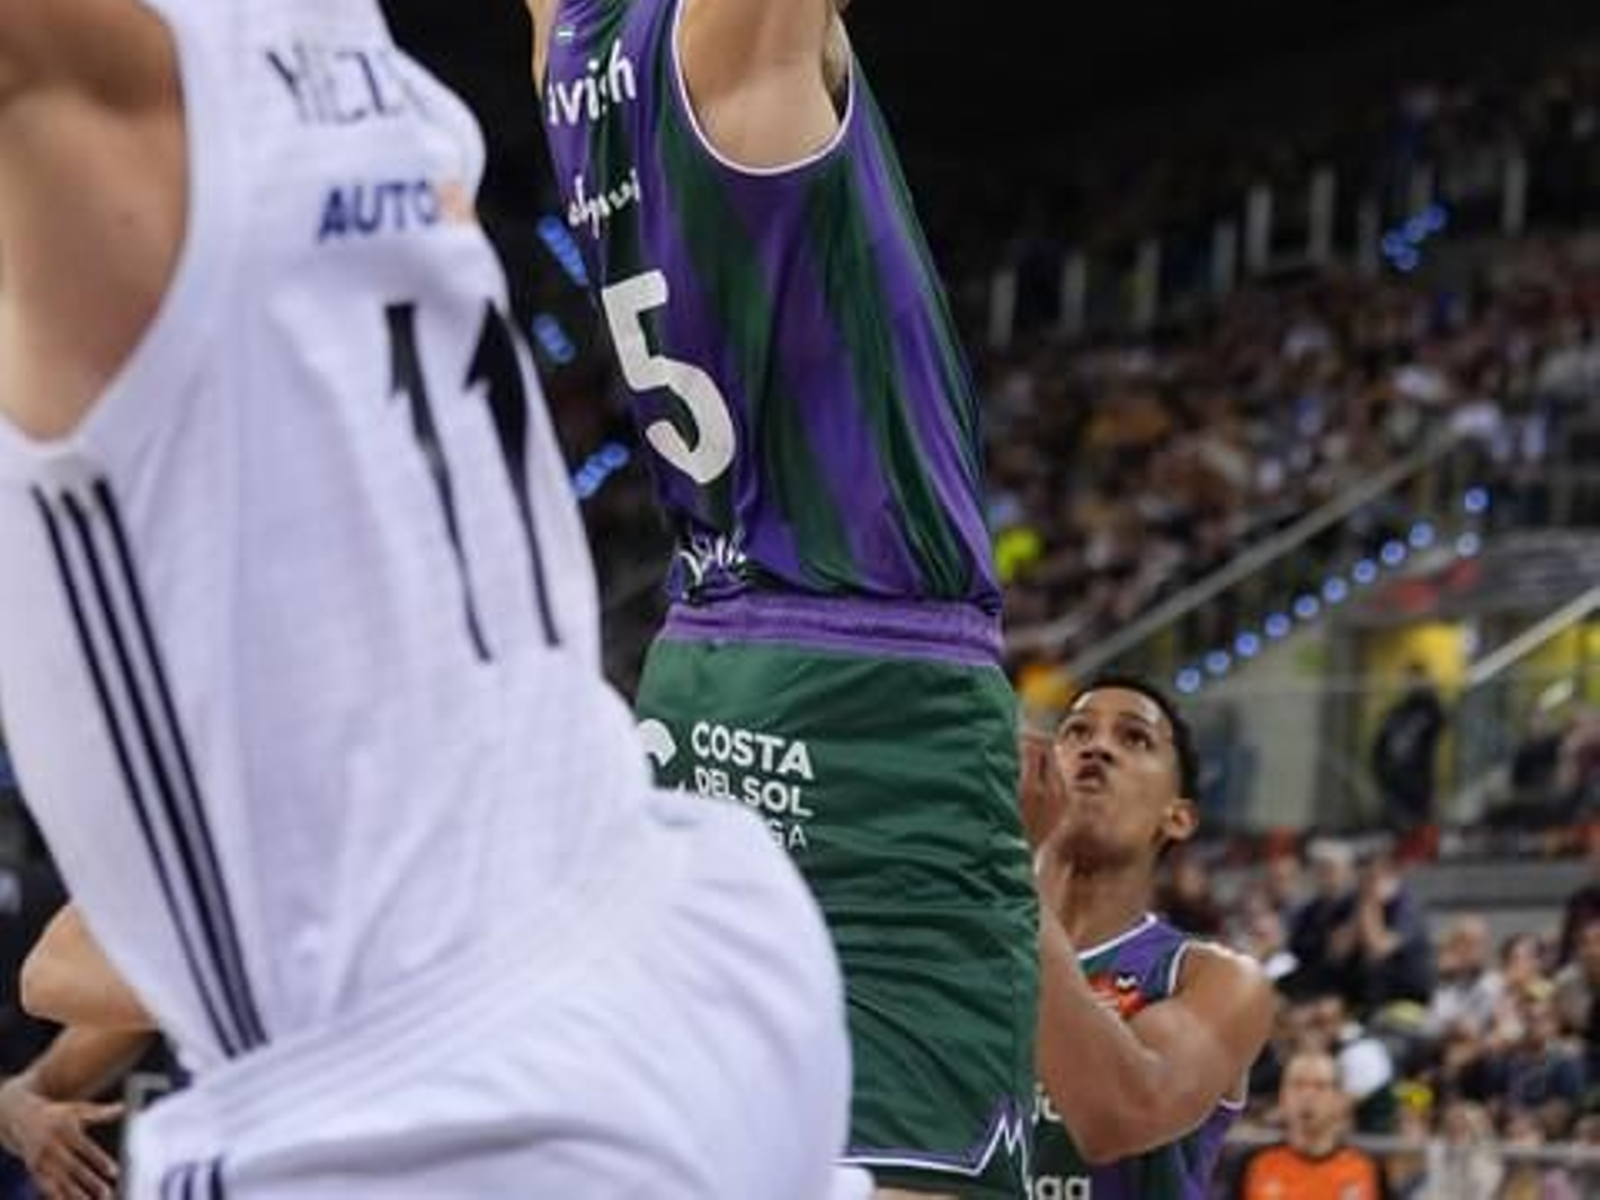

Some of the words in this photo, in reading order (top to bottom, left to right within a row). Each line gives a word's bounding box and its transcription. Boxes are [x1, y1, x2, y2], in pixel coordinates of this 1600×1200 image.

[602, 269, 736, 484] 5
[691, 720, 814, 781] COSTA
[742, 775, 814, 818] SOL
